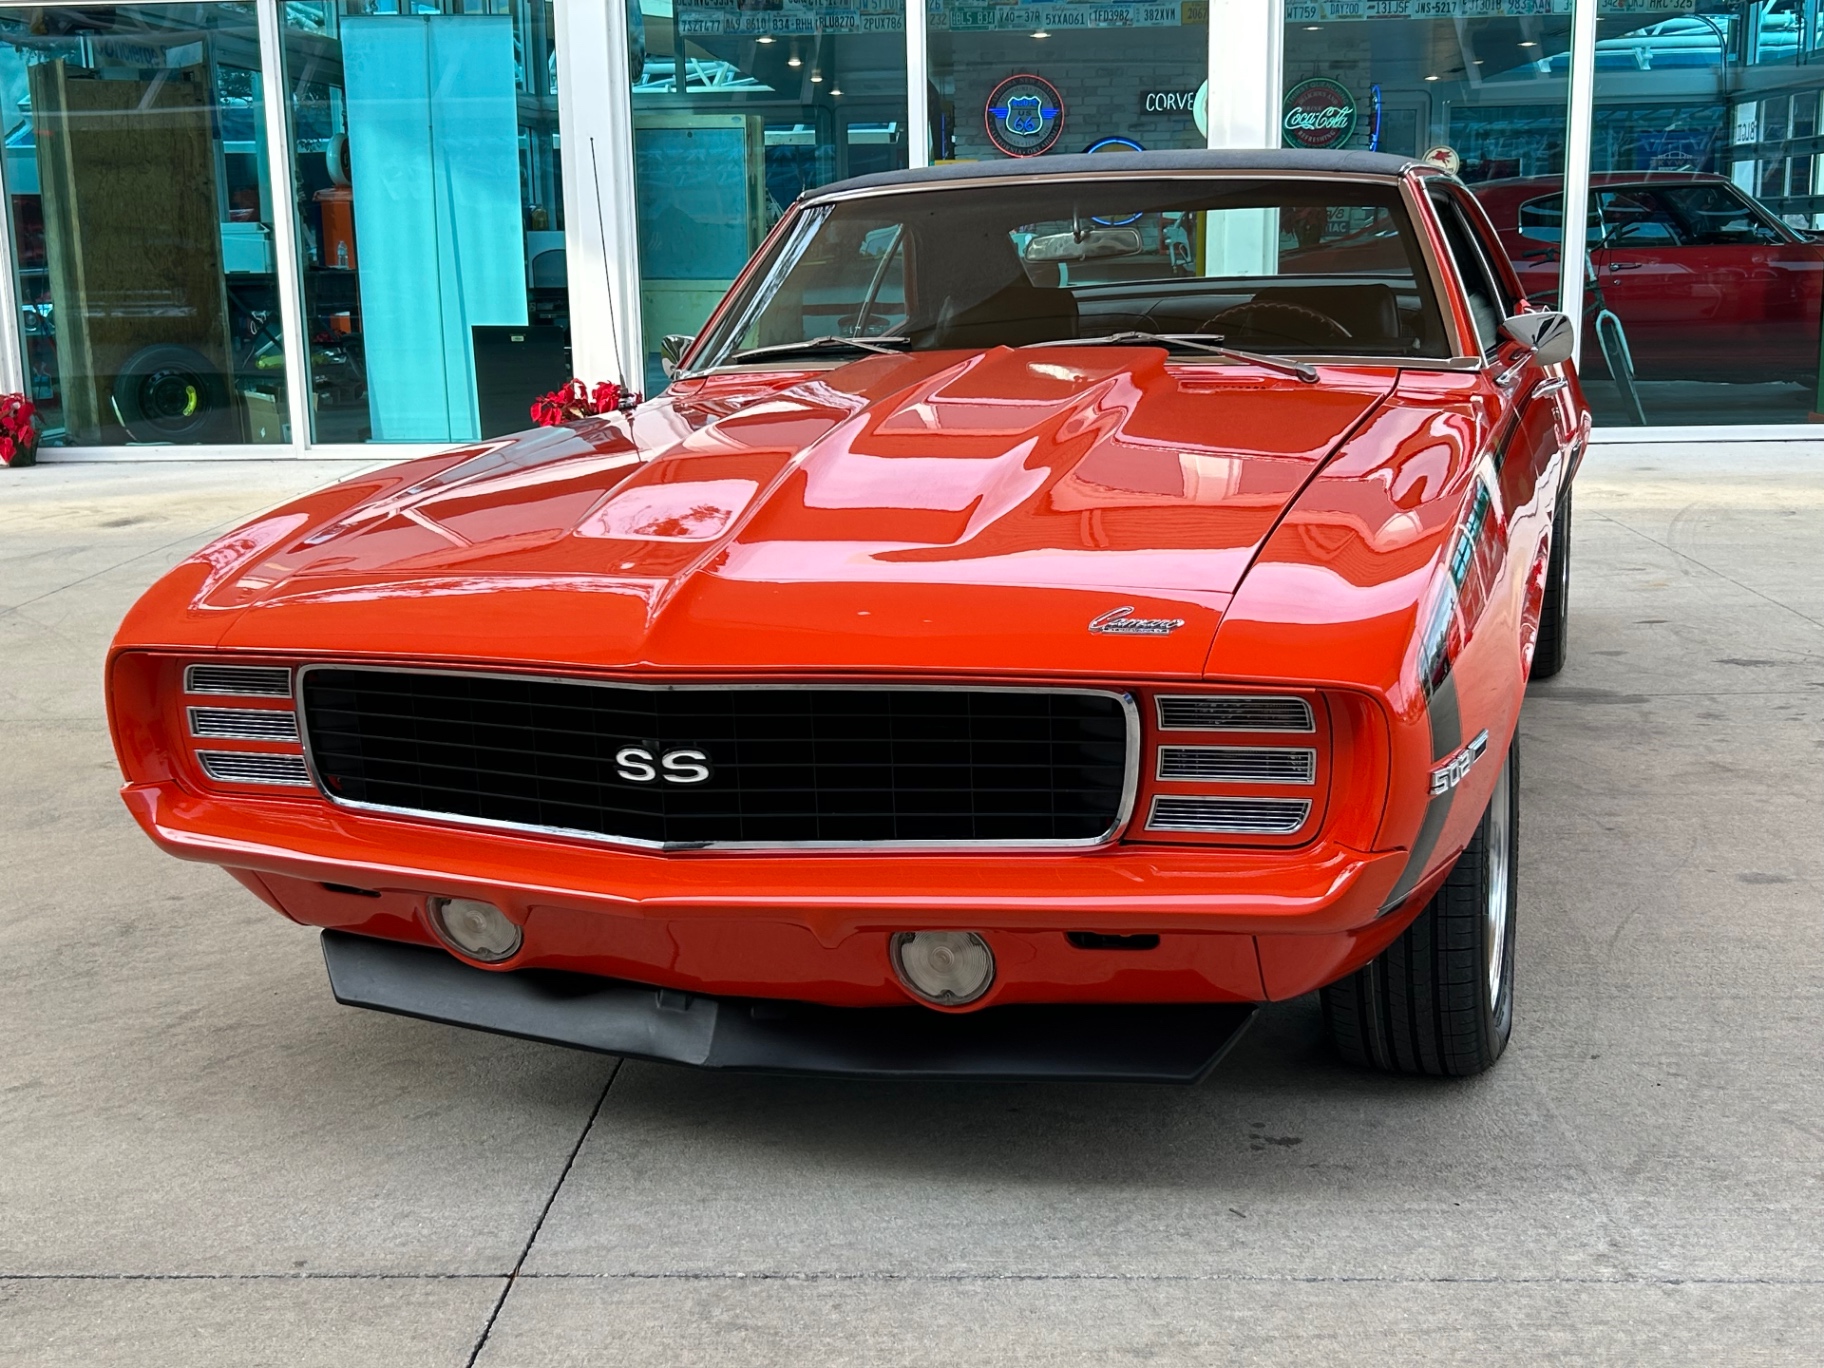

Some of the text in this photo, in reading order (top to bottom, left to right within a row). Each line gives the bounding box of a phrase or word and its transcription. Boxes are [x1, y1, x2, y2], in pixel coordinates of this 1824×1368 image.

[1146, 92, 1194, 111] CORVE
[1014, 116, 1035, 131] 66
[1285, 106, 1353, 130] Coca-Cola
[616, 748, 709, 782] SS
[1430, 749, 1471, 796] 502
